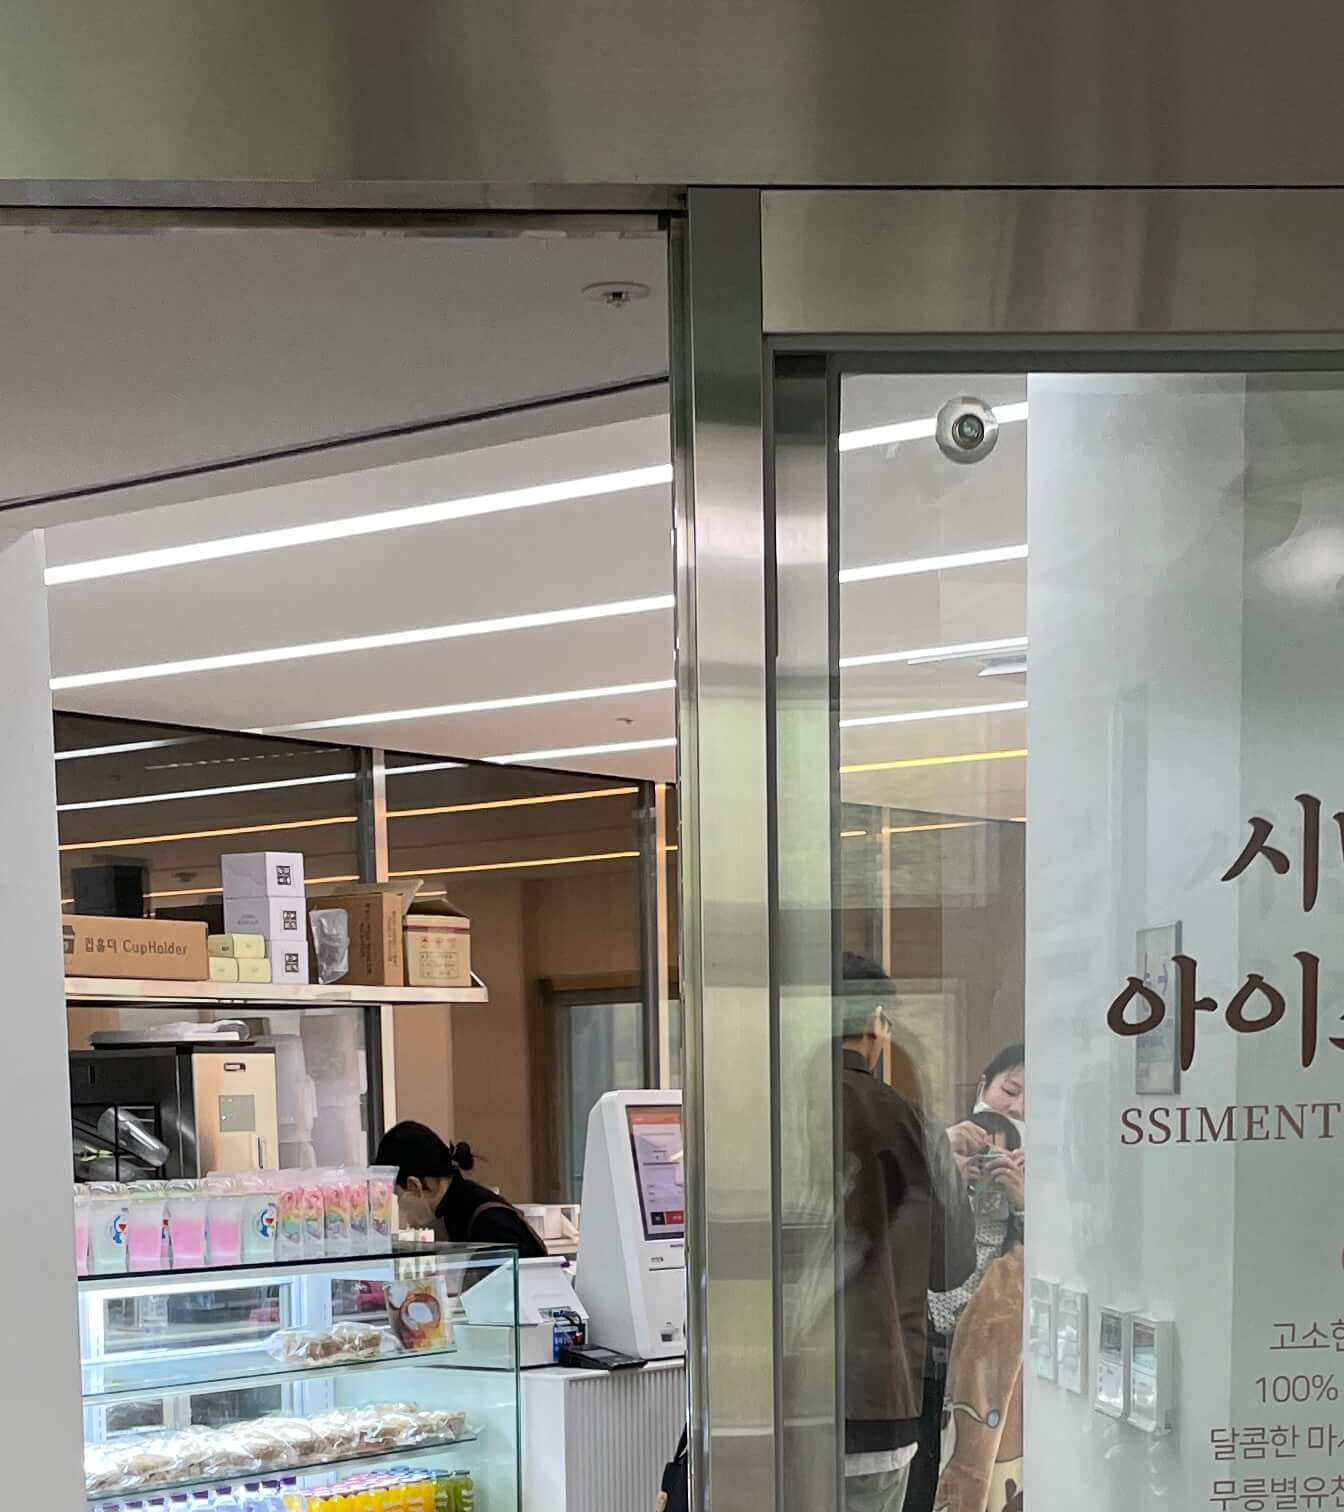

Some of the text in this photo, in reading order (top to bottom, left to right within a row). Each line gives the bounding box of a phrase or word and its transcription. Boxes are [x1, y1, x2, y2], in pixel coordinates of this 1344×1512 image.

[122, 939, 188, 956] CupHolder
[1120, 1102, 1341, 1146] SSIMENT
[1255, 1374, 1339, 1403] 100%
[1209, 1424, 1301, 1461] 달콤한
